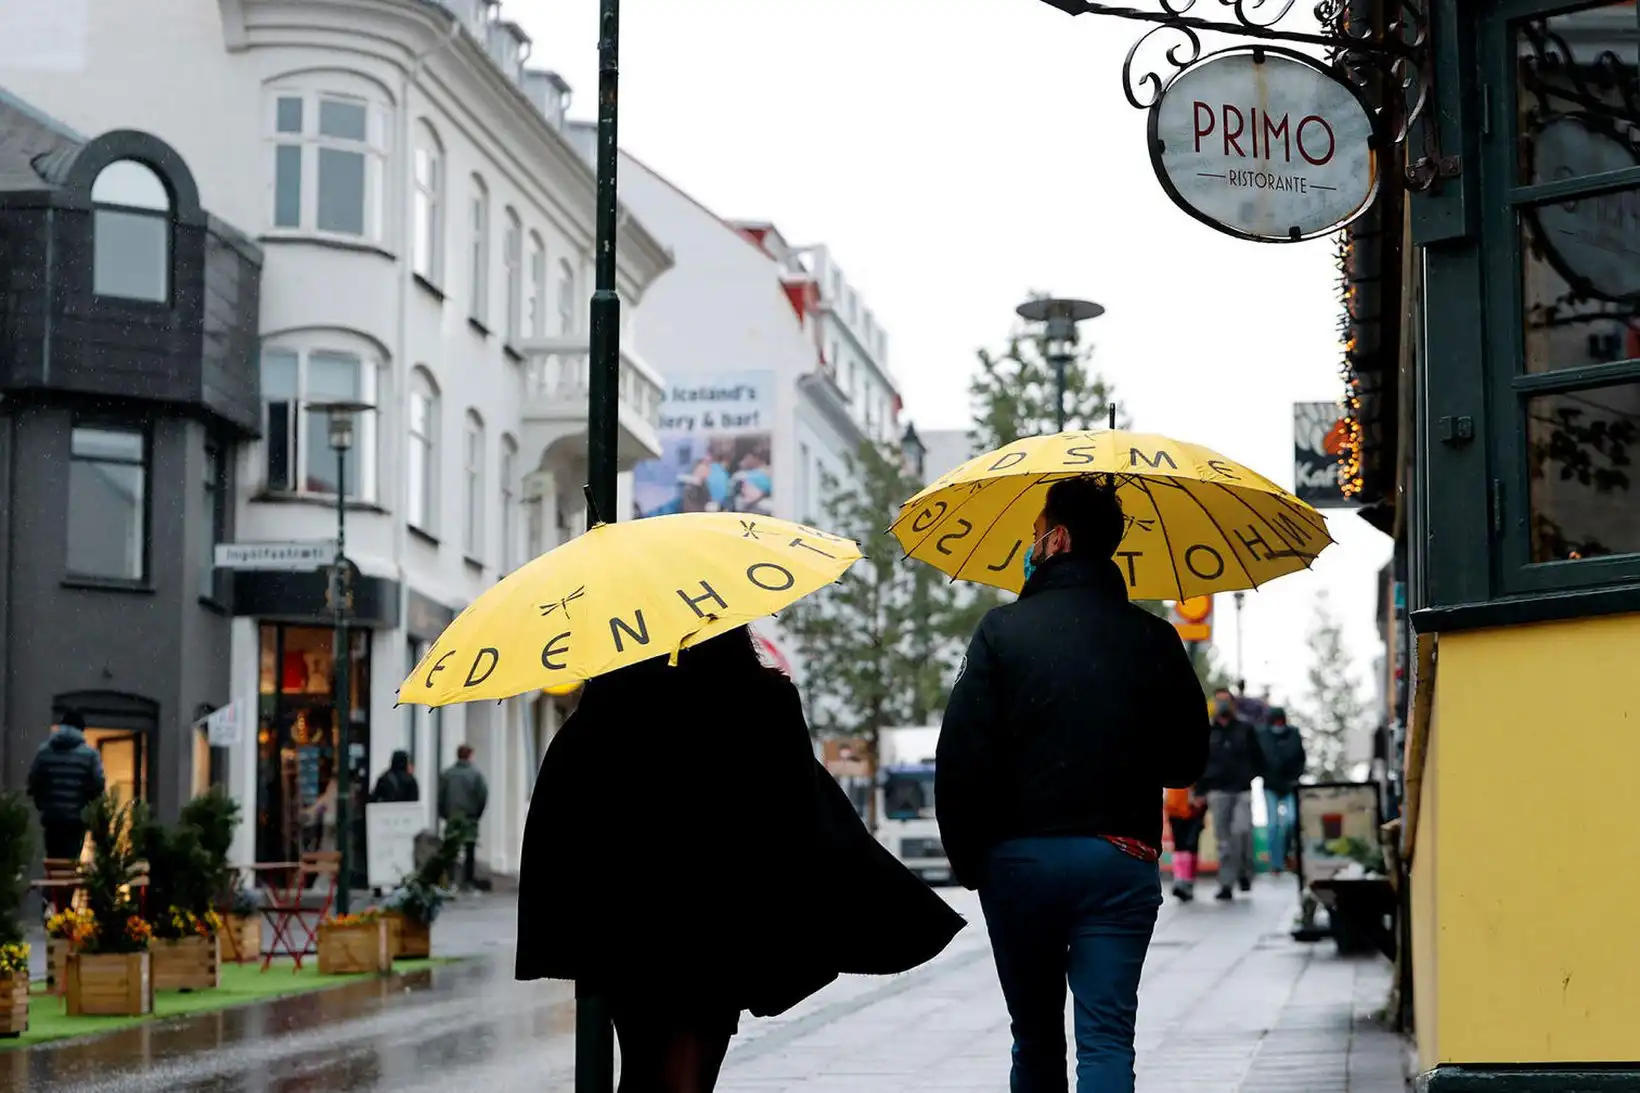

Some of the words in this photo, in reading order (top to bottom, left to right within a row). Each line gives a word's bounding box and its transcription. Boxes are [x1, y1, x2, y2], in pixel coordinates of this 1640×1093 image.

[1193, 101, 1335, 166] PRIMO
[1229, 169, 1307, 194] RISTORANTE
[673, 385, 756, 402] Iceland's
[702, 411, 714, 428] &
